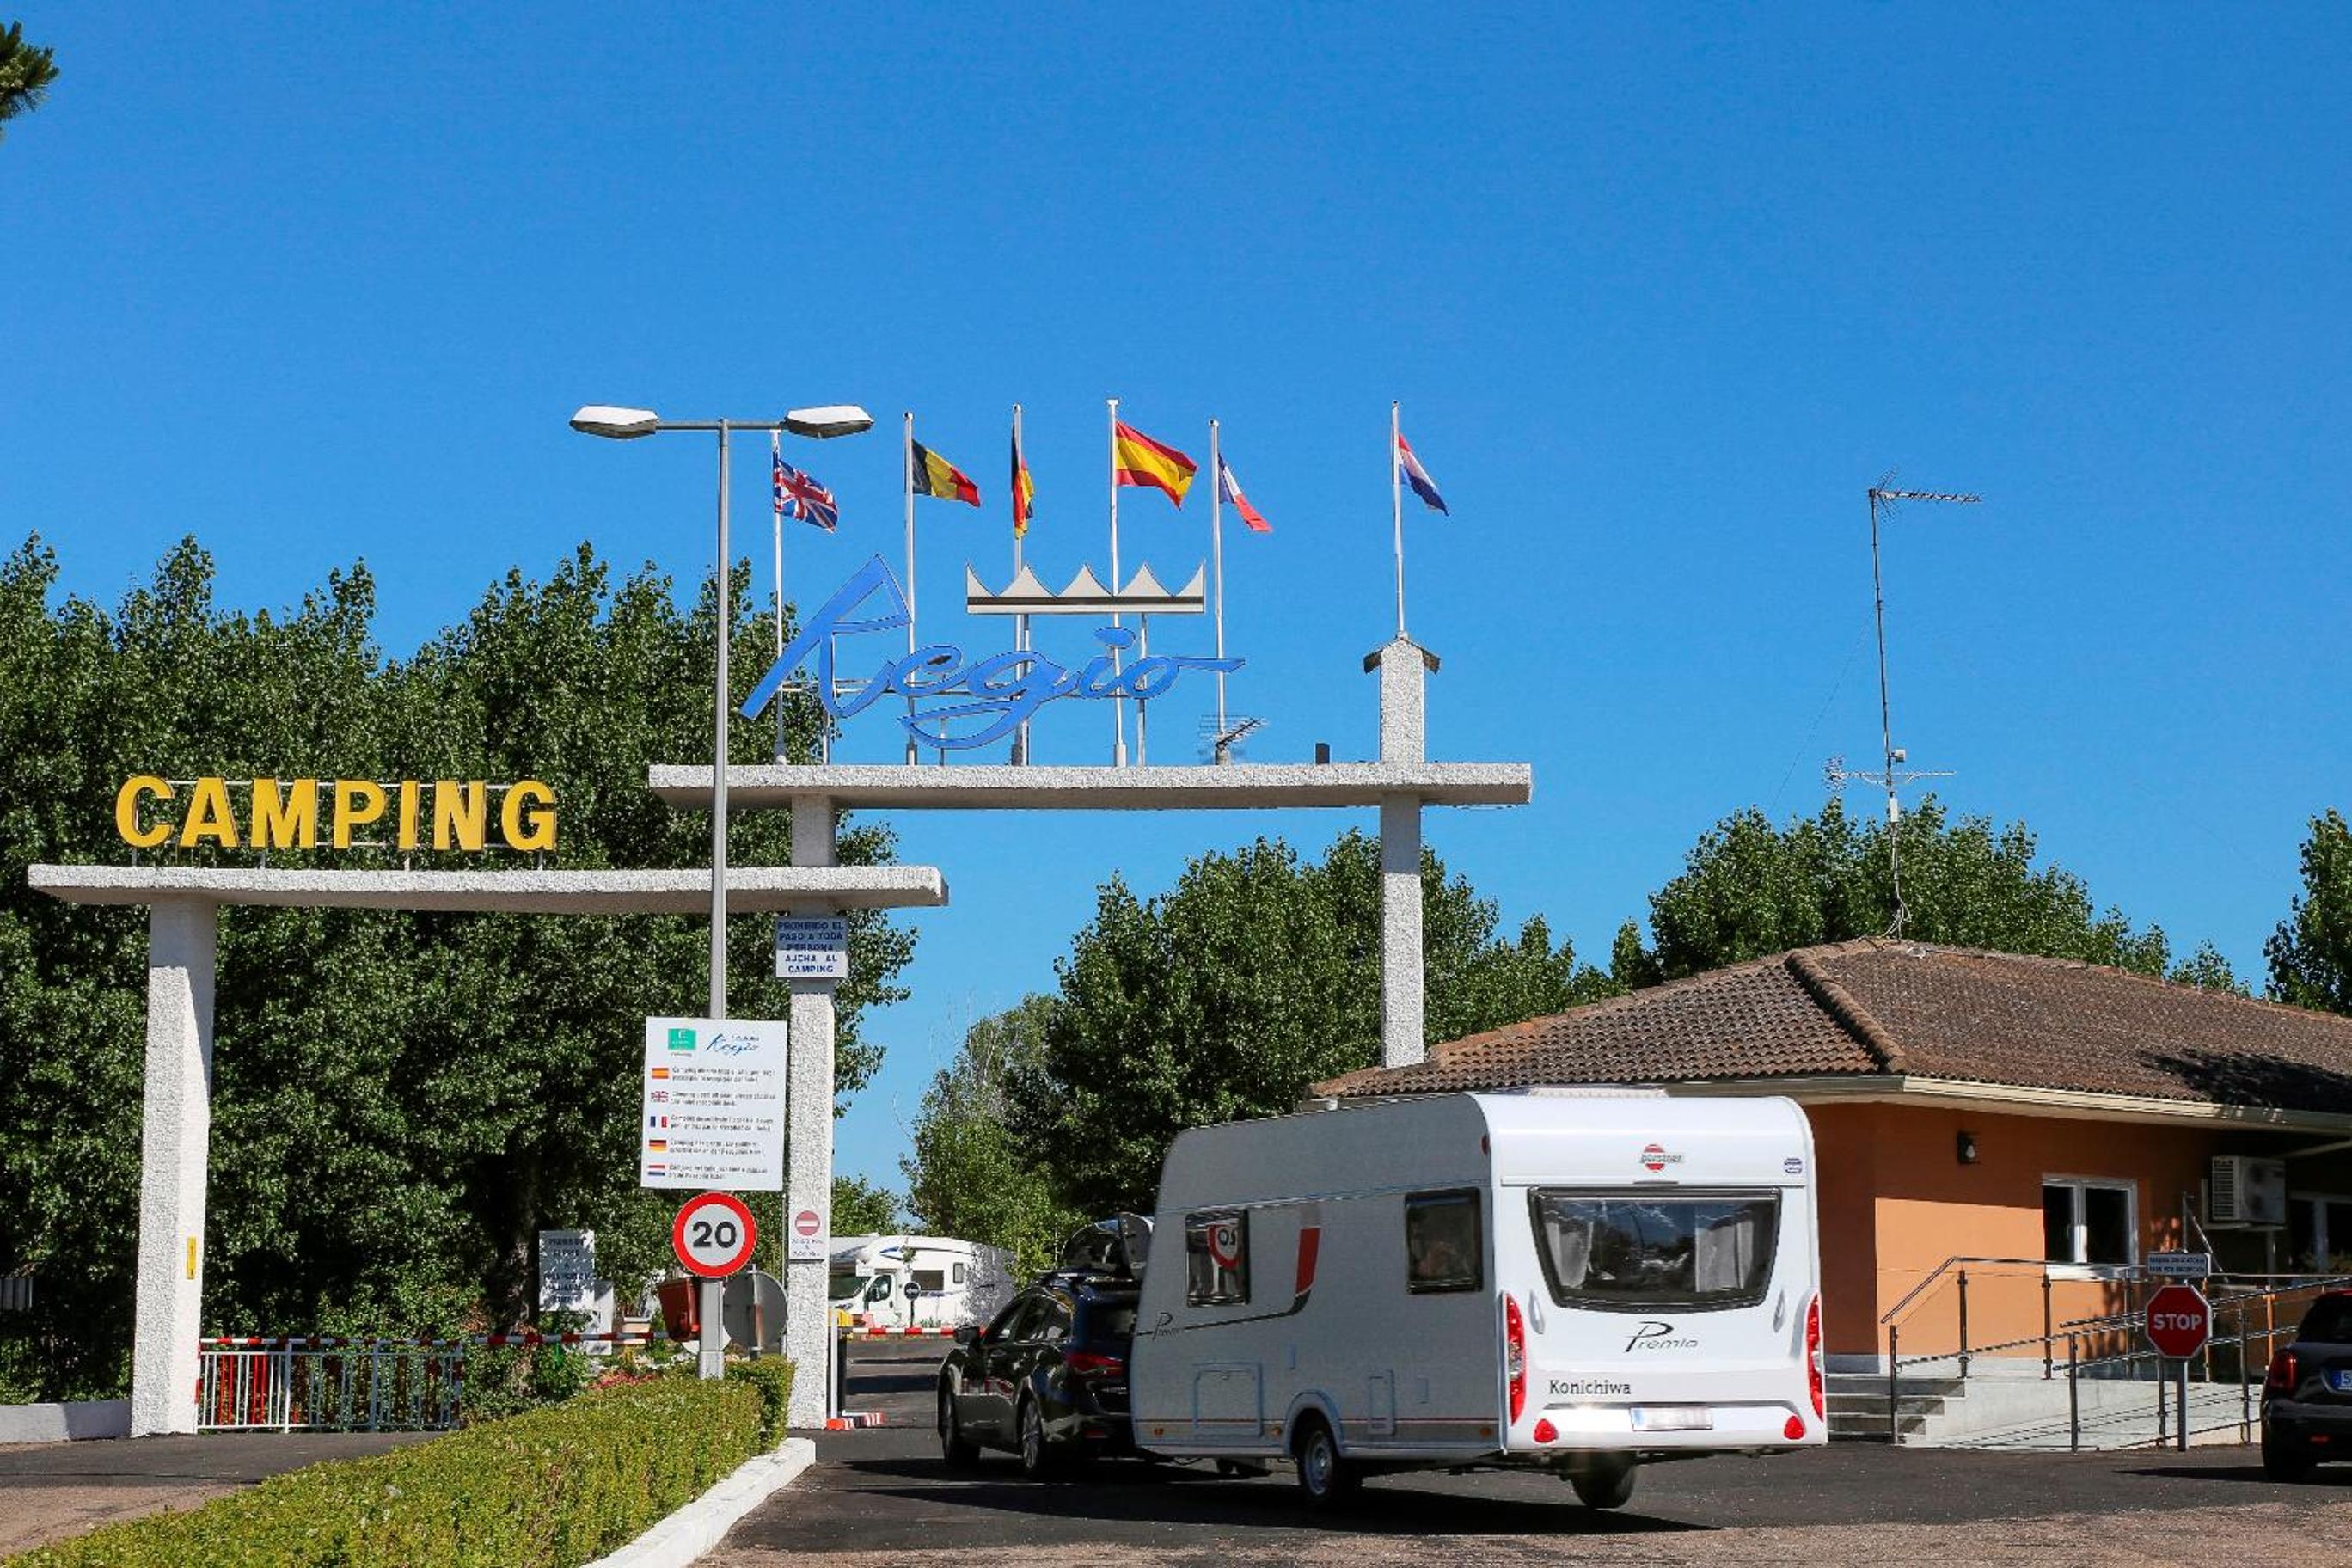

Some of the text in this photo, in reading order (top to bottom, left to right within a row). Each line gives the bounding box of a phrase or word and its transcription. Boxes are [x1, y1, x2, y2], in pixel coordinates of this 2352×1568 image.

[740, 553, 1246, 750] Regio
[115, 775, 558, 852] CAMPING
[779, 932, 805, 941] PASO
[819, 932, 842, 940] TODA
[826, 953, 837, 962] AL
[692, 1220, 738, 1248] 20
[2153, 1313, 2202, 1331] STOP
[1624, 1320, 1699, 1353] Premio
[1548, 1379, 1632, 1395] Konichiwa
